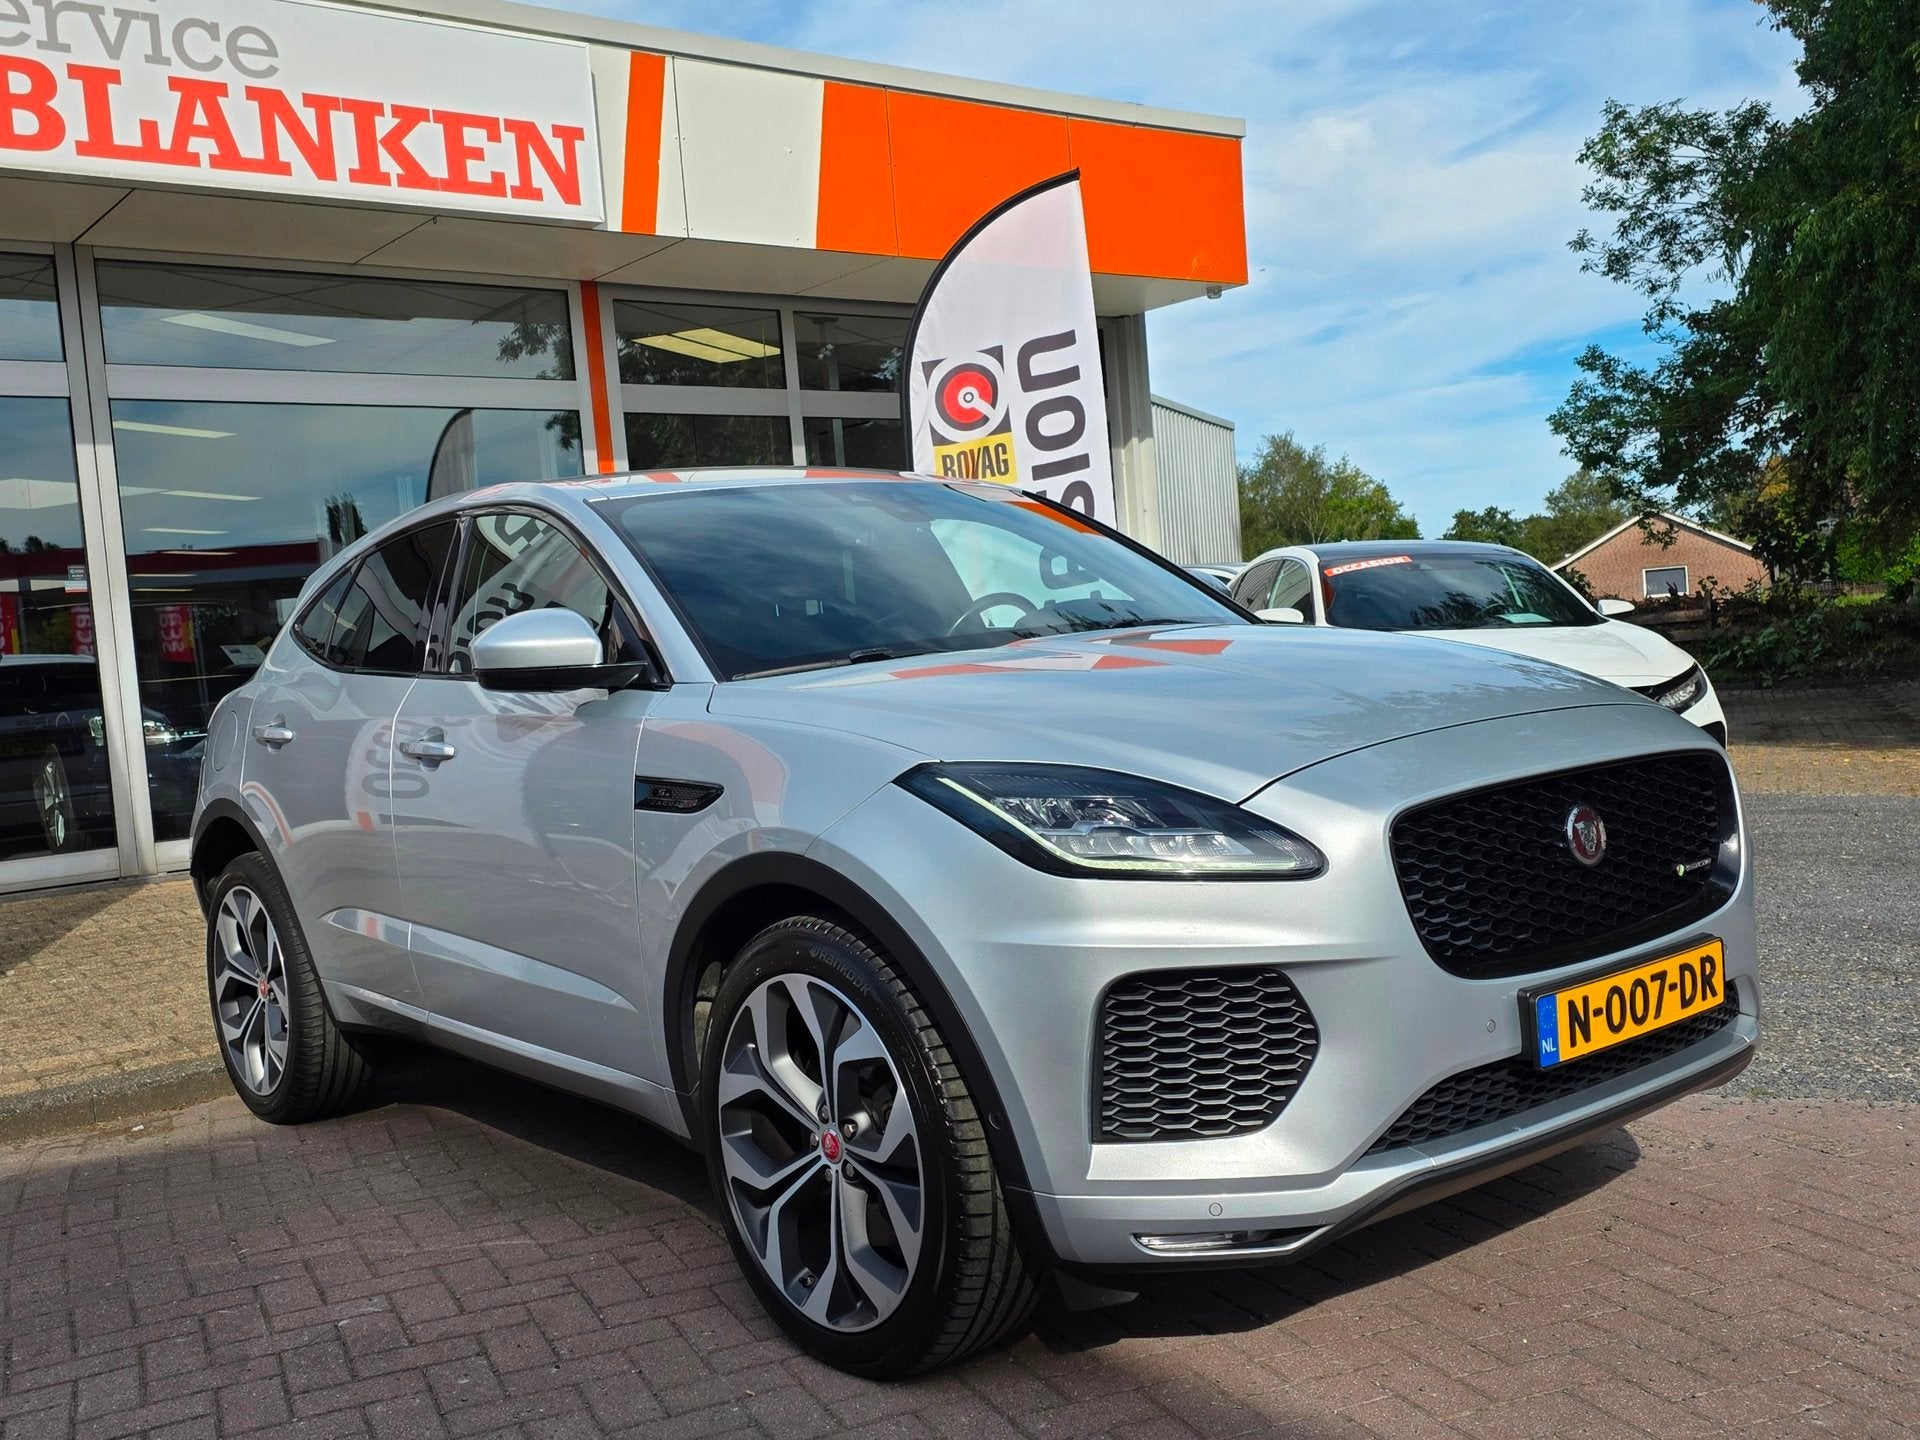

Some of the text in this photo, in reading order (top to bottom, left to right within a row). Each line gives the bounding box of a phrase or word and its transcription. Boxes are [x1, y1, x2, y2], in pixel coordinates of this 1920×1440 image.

[0, 0, 280, 79] ervice
[0, 55, 584, 206] BLANKEN
[1568, 954, 1718, 1048] N-007-DR
[1541, 1037, 1557, 1055] NL
